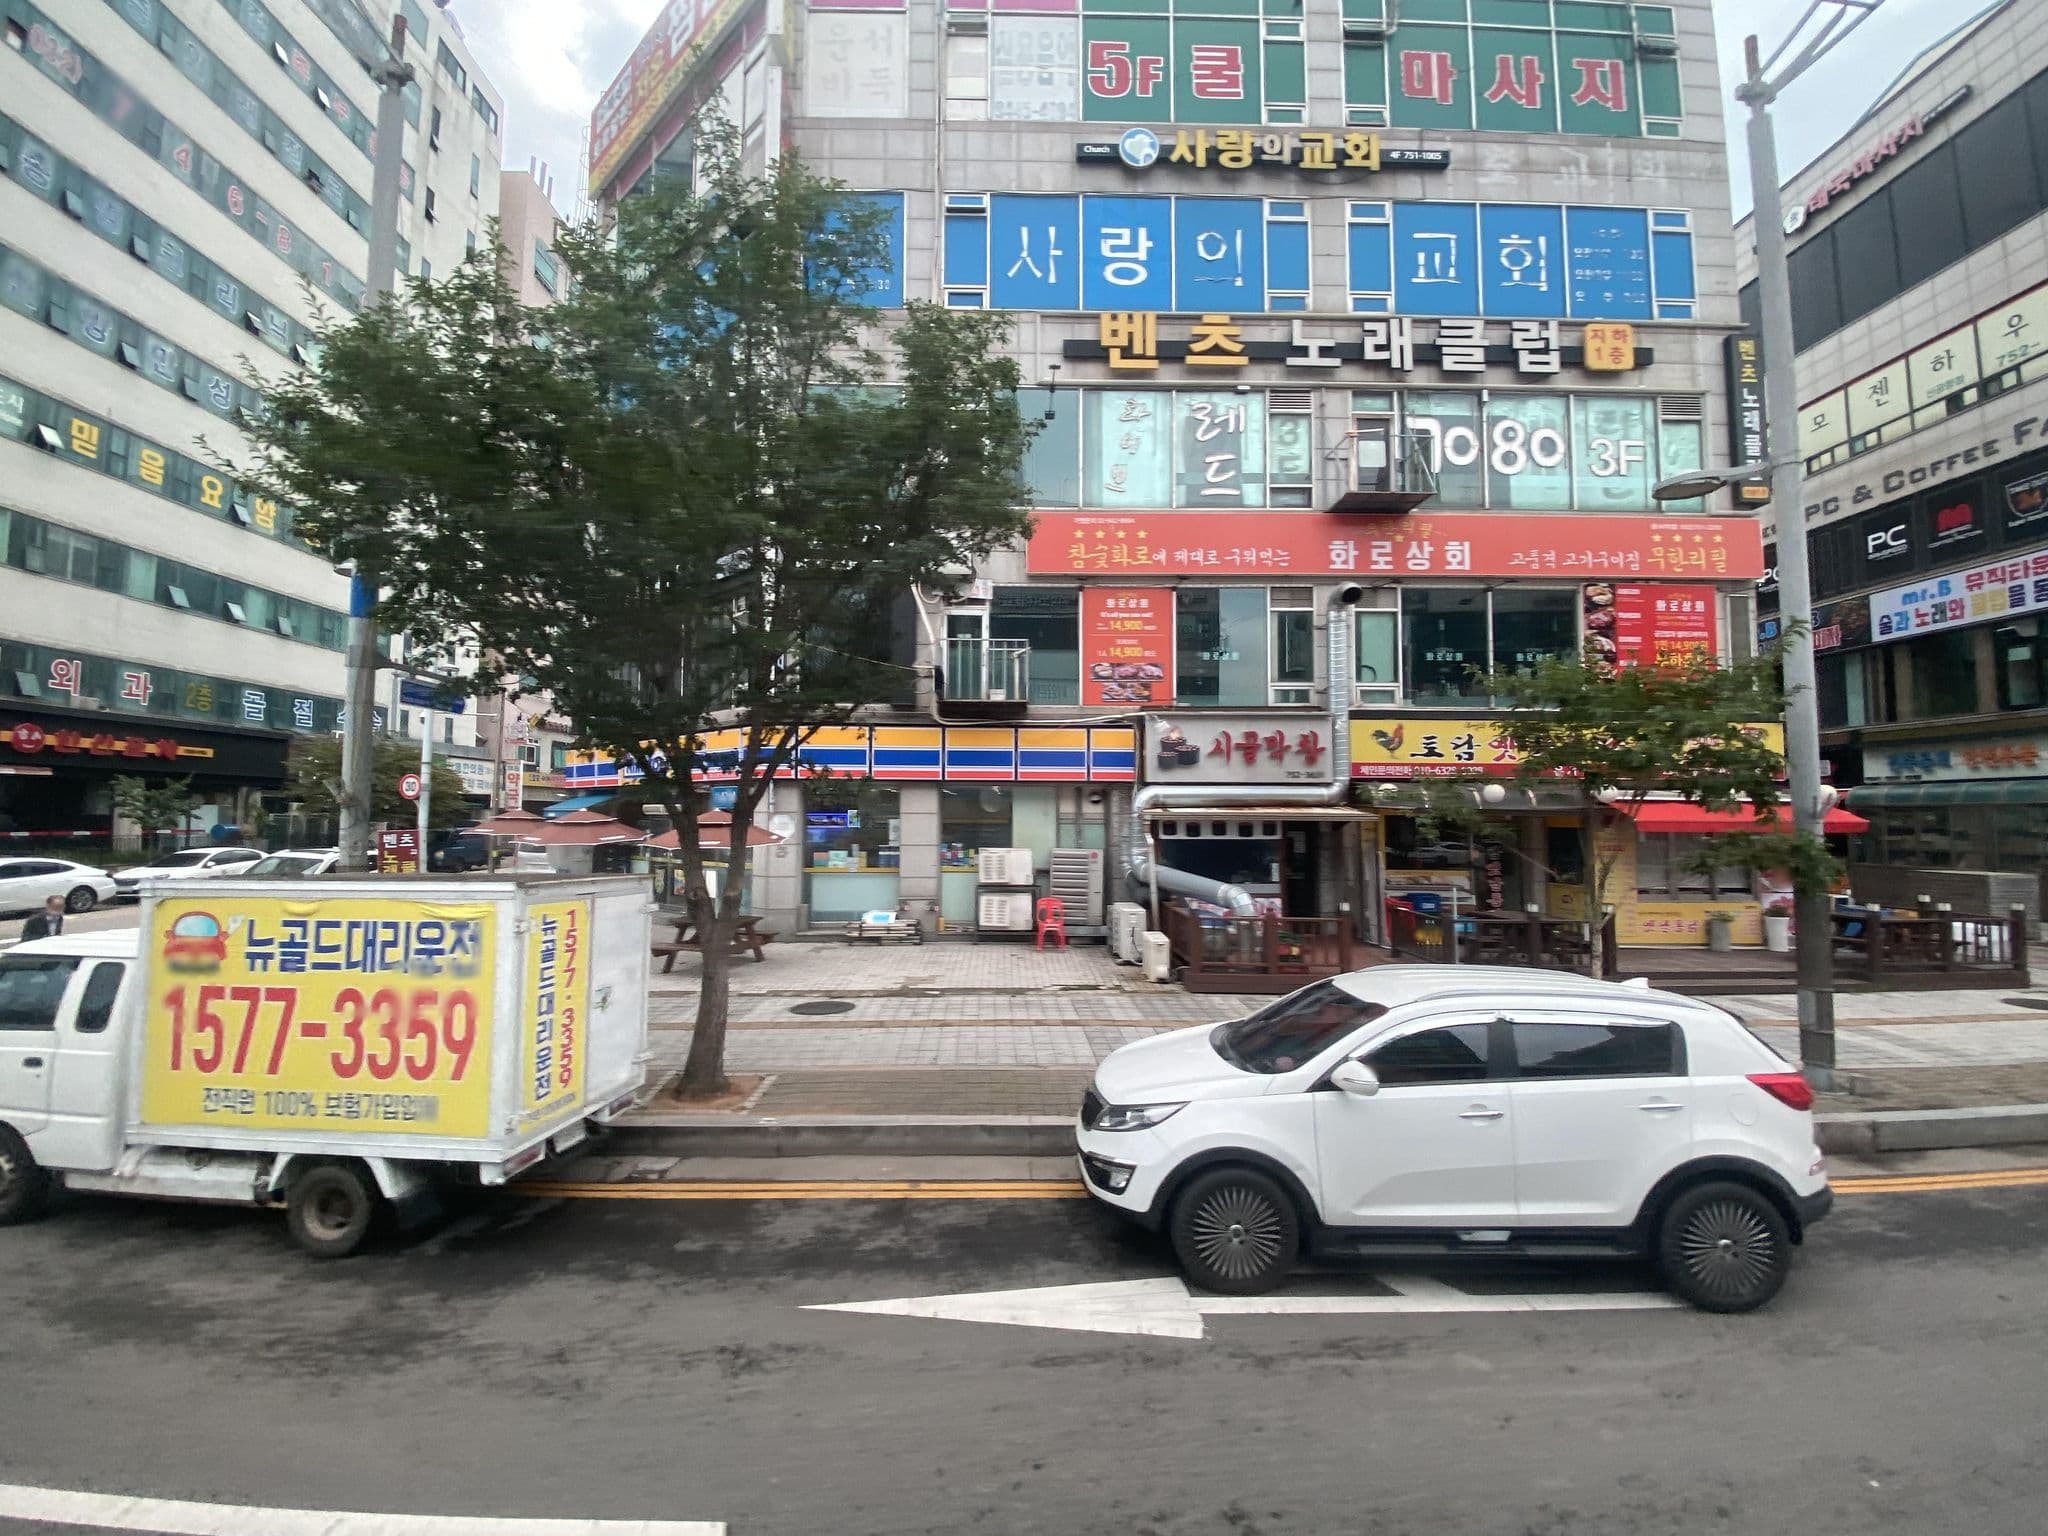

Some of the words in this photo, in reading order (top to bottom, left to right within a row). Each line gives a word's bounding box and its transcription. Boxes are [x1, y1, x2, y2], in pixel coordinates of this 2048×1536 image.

[1088, 41, 1163, 98] 5F
[1191, 45, 1244, 98] 쿨
[1400, 50, 1628, 111] 마사지
[1410, 231, 1550, 292] 교회
[1100, 311, 1251, 370] 벤츠
[1285, 318, 1563, 374] 노래클럽
[1590, 328, 1629, 344] 지하
[1190, 402, 1246, 497] 레드
[1590, 438, 1646, 477] 3F
[1805, 497, 1840, 523] PC
[1328, 540, 1472, 571] 화로상회
[1866, 524, 1907, 555] PC
[405, 781, 417, 793] 30
[164, 984, 478, 1081] 1577-3359
[263, 1091, 318, 1117] 100%
